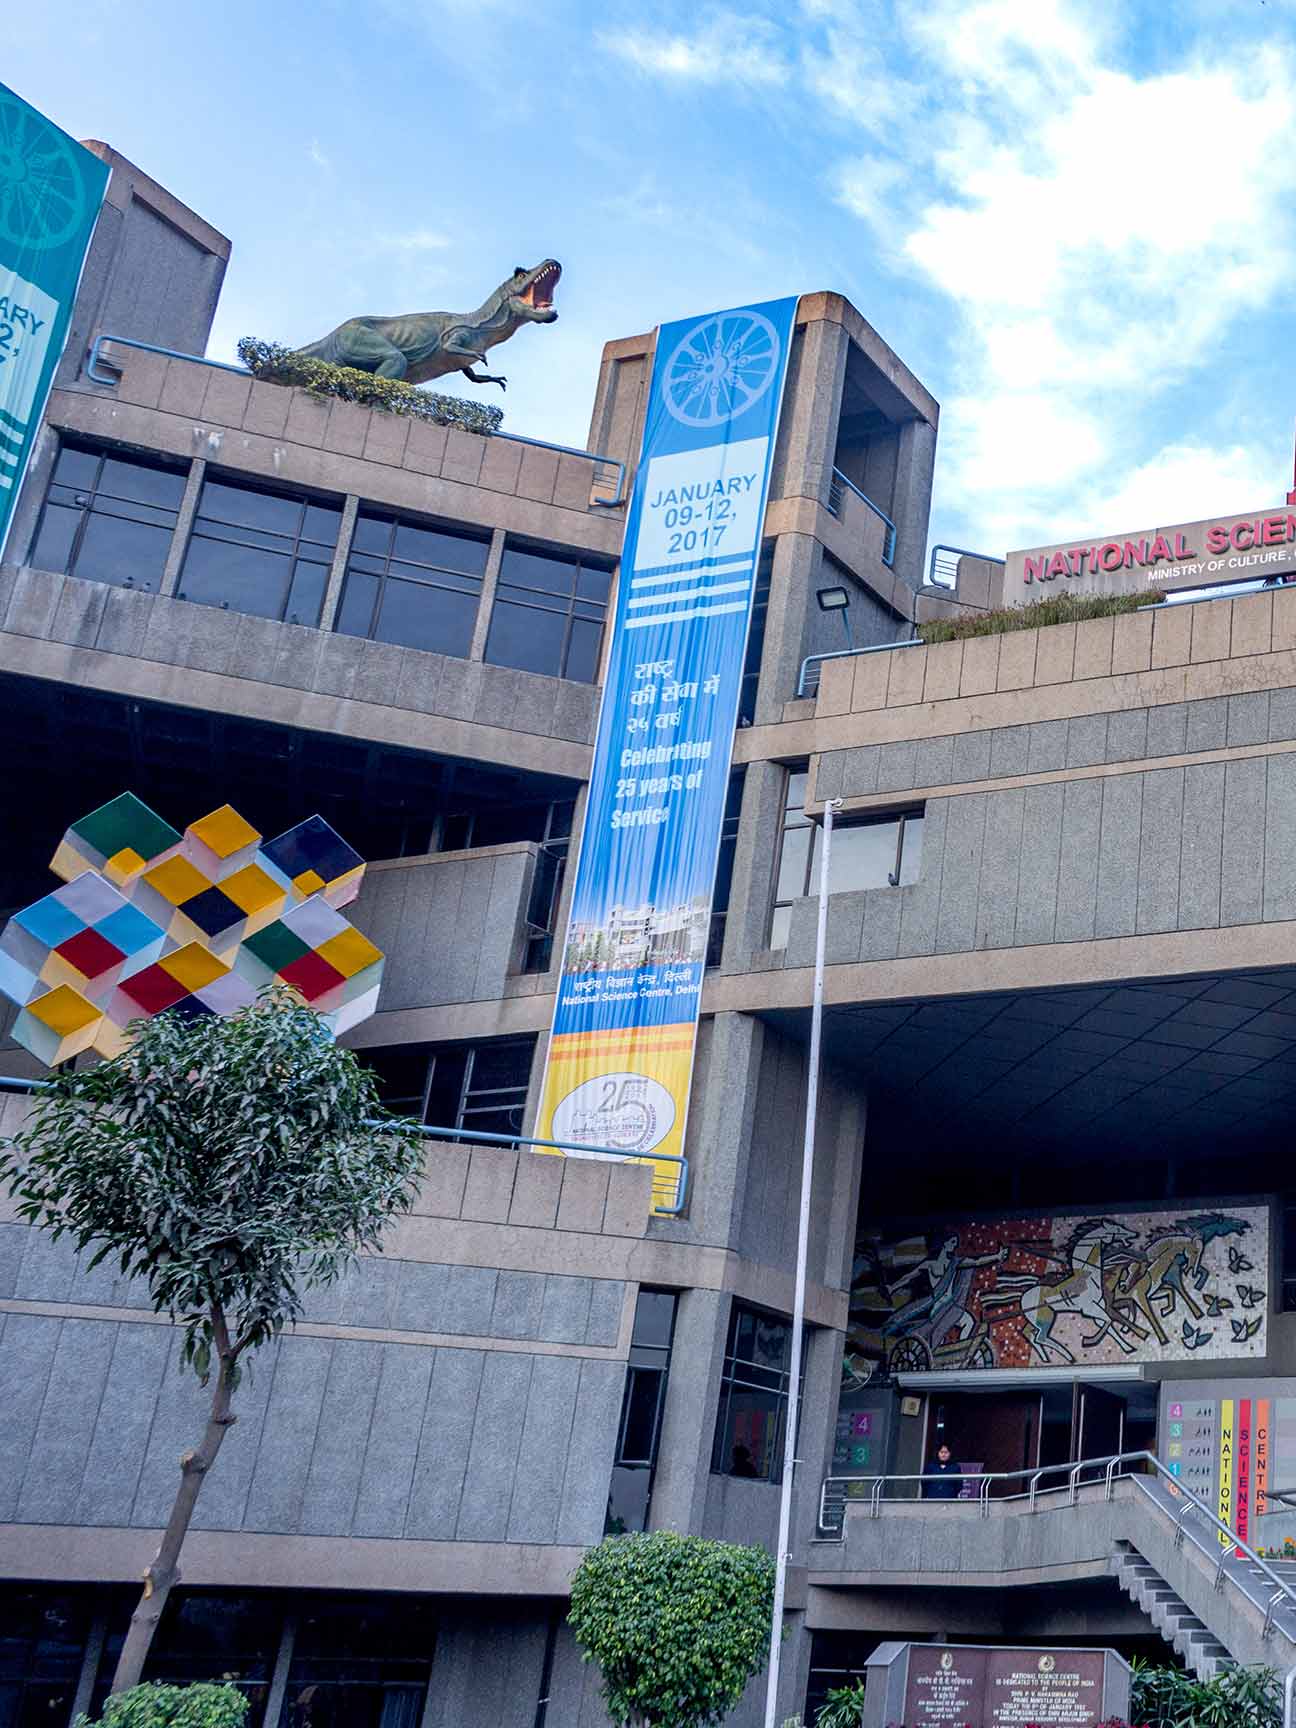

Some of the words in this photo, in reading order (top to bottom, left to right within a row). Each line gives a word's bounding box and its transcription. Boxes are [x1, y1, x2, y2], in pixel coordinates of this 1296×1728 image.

[651, 473, 757, 508] JANUARY
[665, 500, 737, 529] 09-12,
[667, 525, 727, 554] 2017
[1023, 532, 1197, 584] NATIONAL
[1147, 562, 1206, 581] MINISTRY
[1208, 560, 1225, 572] OF
[704, 673, 721, 695] में
[616, 779, 636, 798] 25
[639, 776, 682, 797] yeas
[686, 770, 703, 790] of
[611, 805, 670, 829] Service
[562, 994, 600, 1006] National
[601, 991, 638, 1002] Science
[858, 1416, 868, 1432] 4
[857, 1448, 866, 1463] 3
[1238, 1430, 1248, 1537] SCIENCE
[1256, 1428, 1267, 1517] CENTRE
